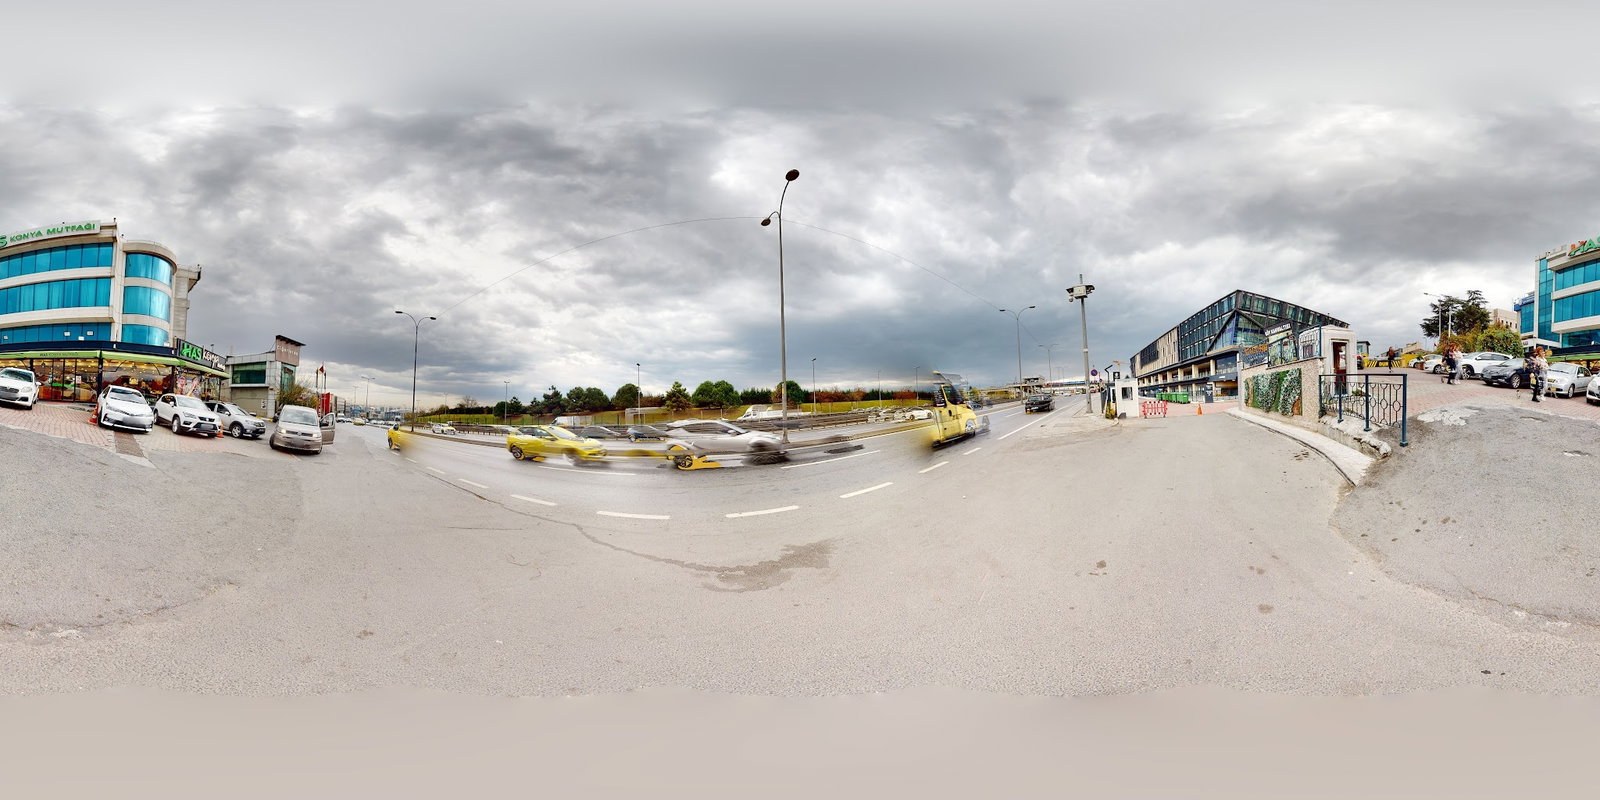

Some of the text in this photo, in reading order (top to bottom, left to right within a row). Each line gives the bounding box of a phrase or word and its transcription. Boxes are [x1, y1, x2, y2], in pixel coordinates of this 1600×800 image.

[9, 230, 43, 242] KONYA
[47, 223, 96, 235] MUTFAĞI
[181, 342, 202, 361] HAS
